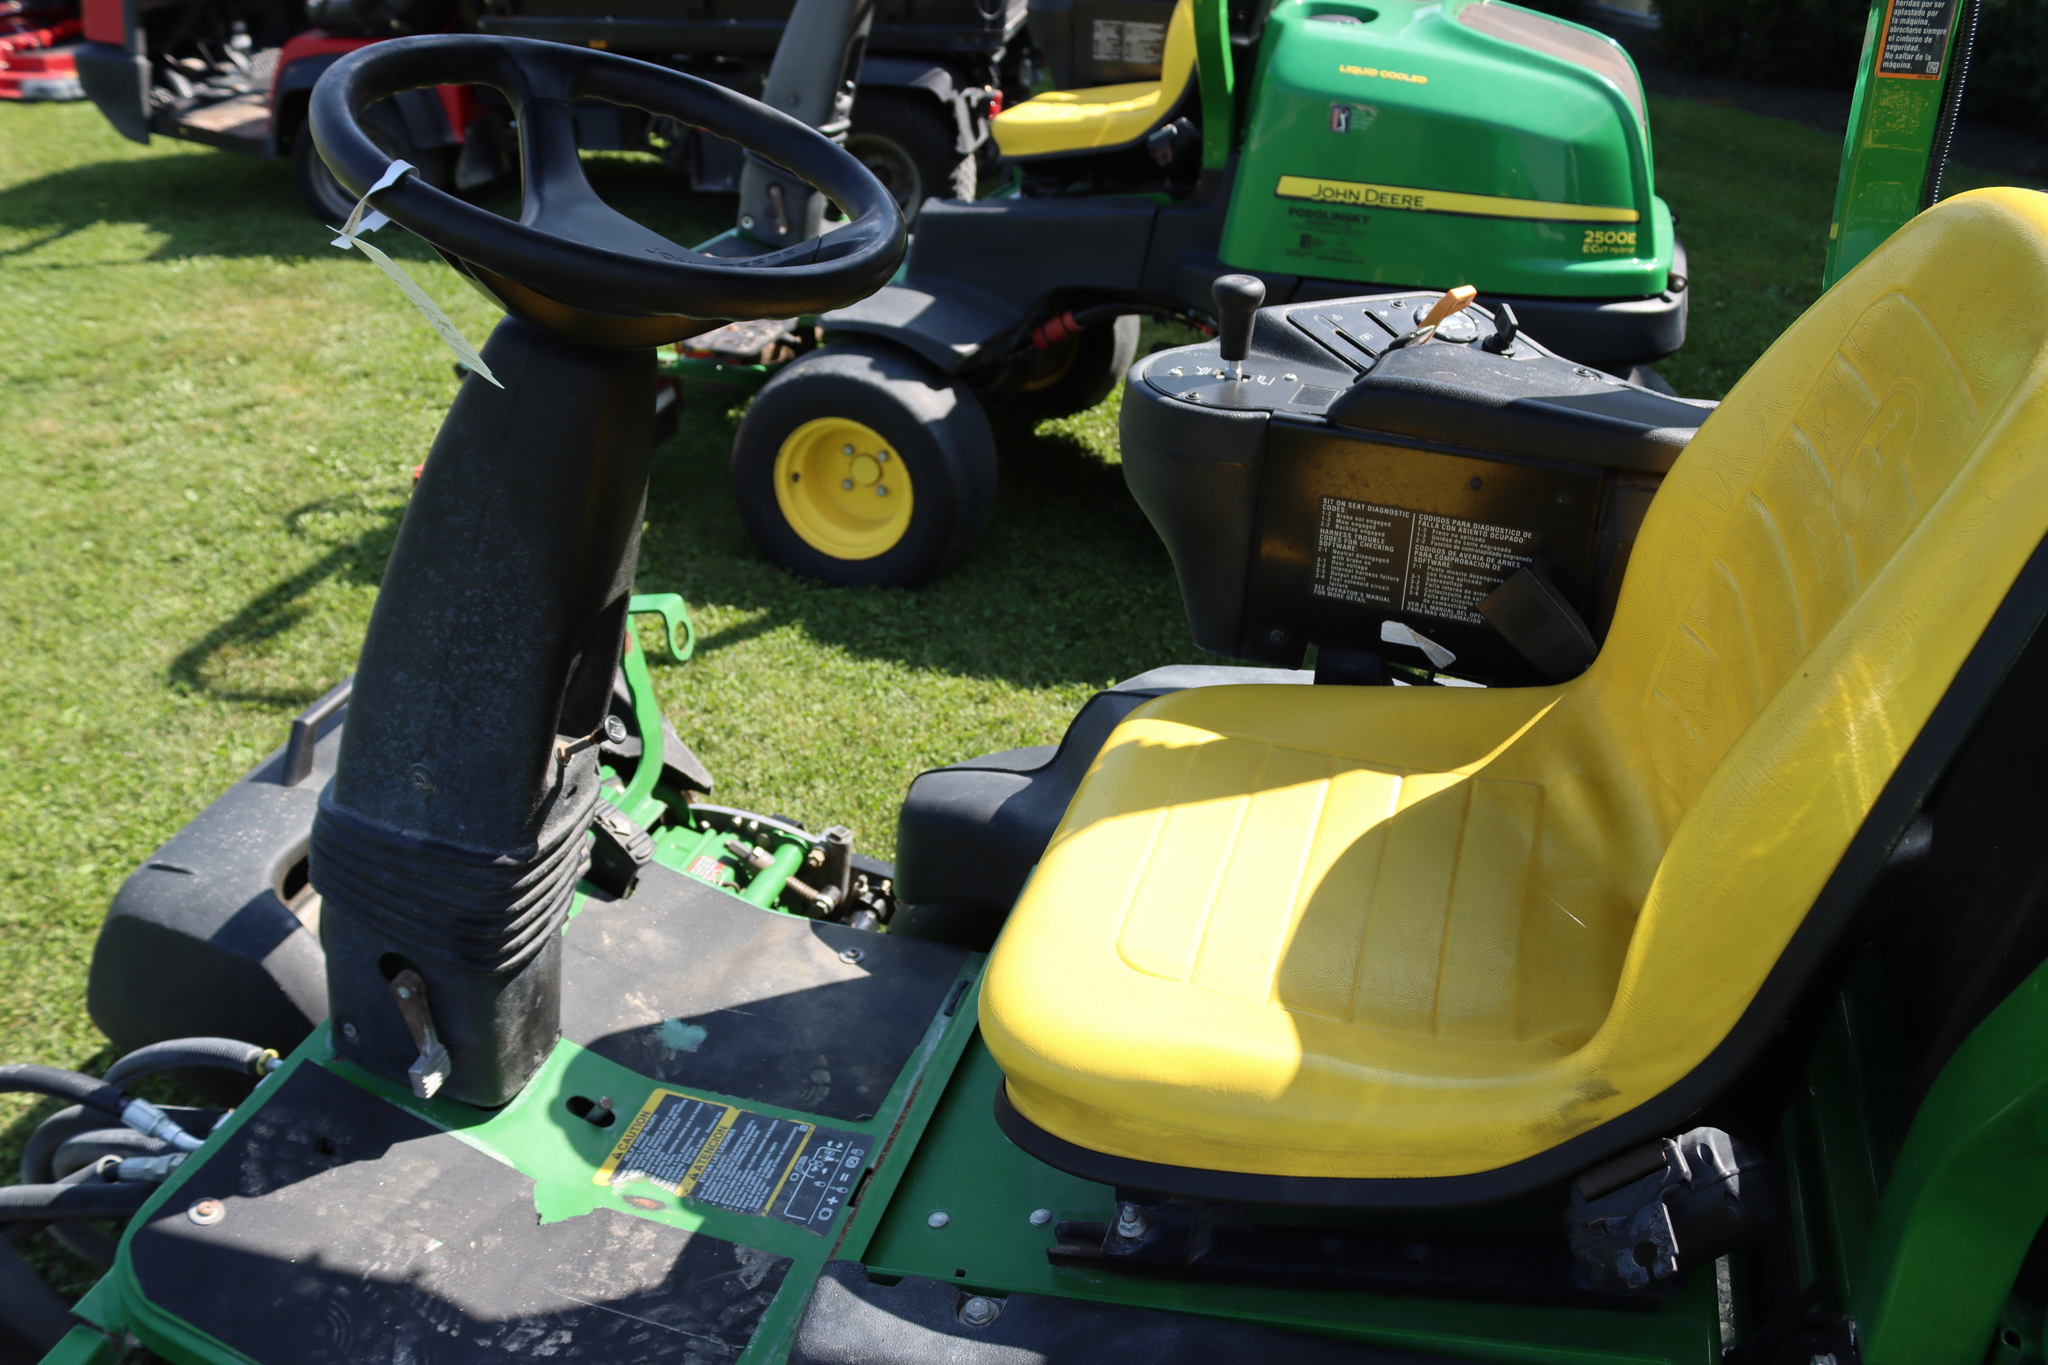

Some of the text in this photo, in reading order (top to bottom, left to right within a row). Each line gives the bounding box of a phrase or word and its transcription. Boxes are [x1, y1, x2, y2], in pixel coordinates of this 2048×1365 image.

[1921, 1, 1932, 9] por
[1894, 8, 1925, 17] aplastado
[1900, 18, 1930, 26] máquina,
[1923, 28, 1947, 36] siempre
[1886, 44, 1920, 52] seguridad.
[1883, 61, 1912, 69] máquina.
[1339, 64, 1428, 85] LIQUID COOLED
[1583, 230, 1636, 245] 2500E
[1322, 497, 1333, 505] SIT
[1348, 502, 1365, 510] SEAT
[1367, 505, 1409, 518] DIAGNOSTIC
[1322, 503, 1347, 513] CODES:
[1350, 521, 1376, 530] engaged
[1366, 518, 1391, 527] engaged
[1418, 513, 1449, 524] CODIGOS
[1452, 519, 1470, 528] PARA
[1472, 523, 1520, 536] DIAGNOSTICO
[1319, 528, 1385, 544] HARNESS TROUBLE
[1335, 524, 1358, 532] Backlap
[1360, 528, 1385, 537] engaged
[1418, 519, 1439, 529] FALLA
[1457, 526, 1487, 537] ASIENTO
[1489, 532, 1526, 544] OCUPADO:
[1319, 534, 1342, 542] CODES
[1359, 541, 1394, 552] CHECKING
[1459, 534, 1485, 544] aplicado
[1318, 540, 1358, 551] SOFTWARE:
[1479, 544, 1511, 554] engranada
[1332, 548, 1354, 556] Neutral
[1355, 553, 1389, 563] disengaged
[1413, 550, 1432, 559] PARA
[1434, 554, 1490, 568] COMPROBACION
[1414, 544, 1445, 554] CODIGOS
[1458, 552, 1483, 561] AVERIA
[1497, 558, 1520, 568] ARNES
[1503, 553, 1532, 563] engranada
[1346, 562, 1368, 570] voltage
[1413, 556, 1453, 568] SOFTWARE:
[1330, 565, 1353, 573] Internal
[1355, 569, 1378, 578] harness
[1330, 570, 1349, 578] Output
[1446, 569, 1467, 577] muerto
[1468, 573, 1504, 584] desengrana
[1344, 578, 1368, 587] solenoid
[1425, 576, 1462, 588] Sobrevoltaje
[1456, 577, 1482, 585] aplicado
[1326, 586, 1364, 597] OPERATOR'S
[1365, 593, 1390, 602] MANUAL
[1327, 591, 1344, 599] MORE
[1346, 595, 1366, 603] DETAIL
[1424, 587, 1461, 598] Cortocircuito
[1431, 600, 1467, 610] combustible
[1451, 598, 1473, 606] circuito
[1429, 605, 1454, 614] MANUAL
[1439, 612, 1481, 624] INFORMACION
[618, 1111, 651, 1150] CAUTION
[694, 1125, 728, 1171] ATENCION
